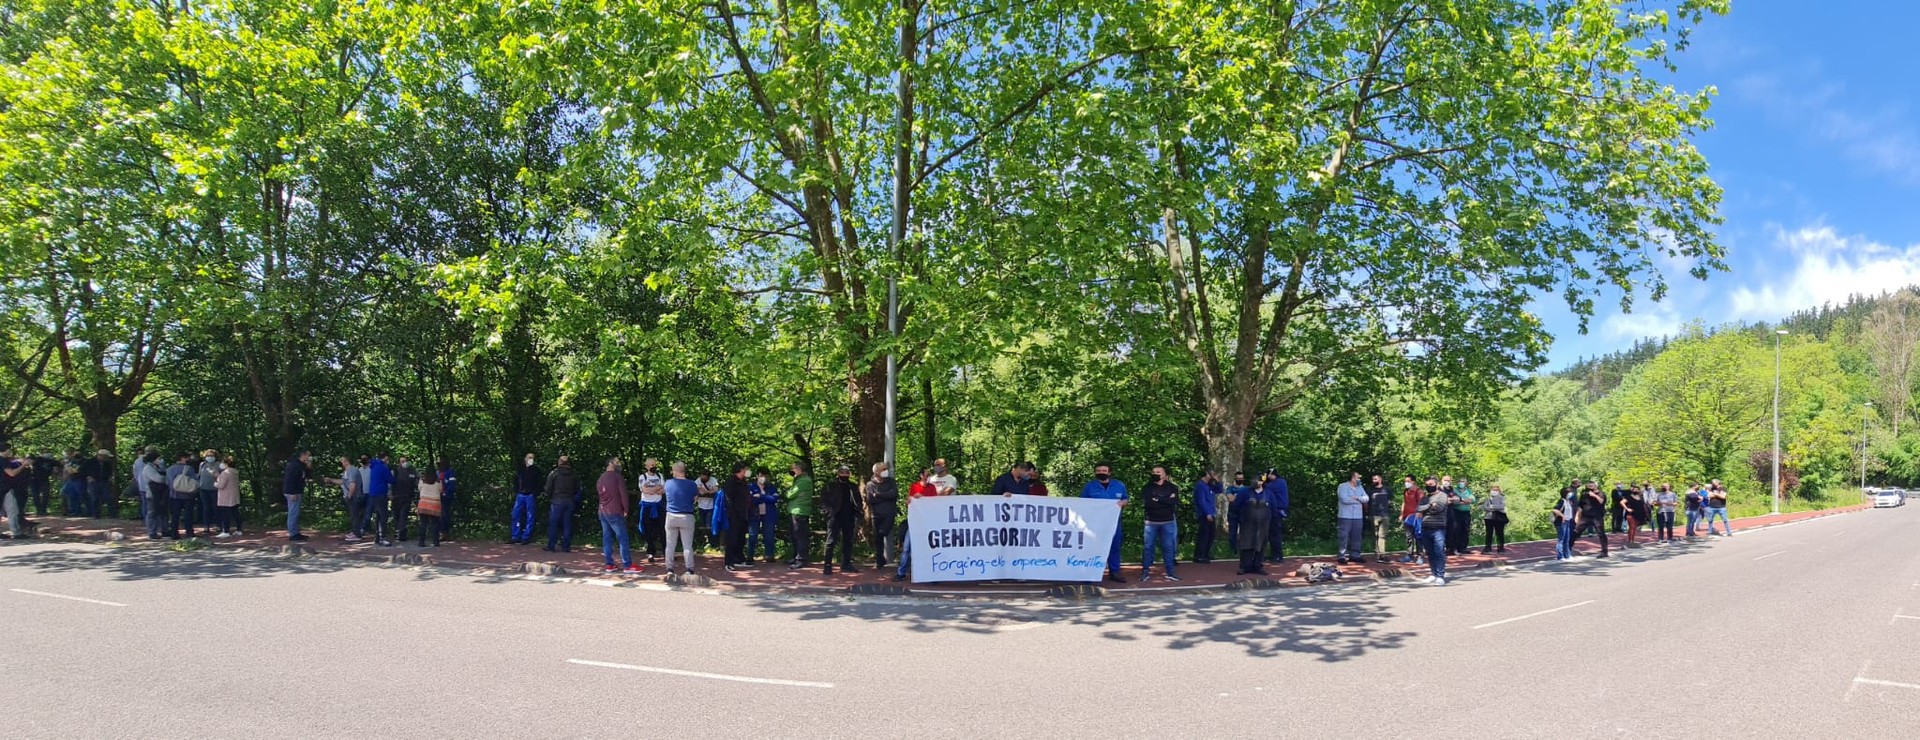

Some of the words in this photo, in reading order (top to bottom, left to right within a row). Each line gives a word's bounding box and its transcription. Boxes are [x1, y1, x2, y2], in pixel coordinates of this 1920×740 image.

[948, 503, 984, 523] LAN
[994, 502, 1070, 526] ISTRIPU
[928, 527, 1041, 549] GEHIAGORIK
